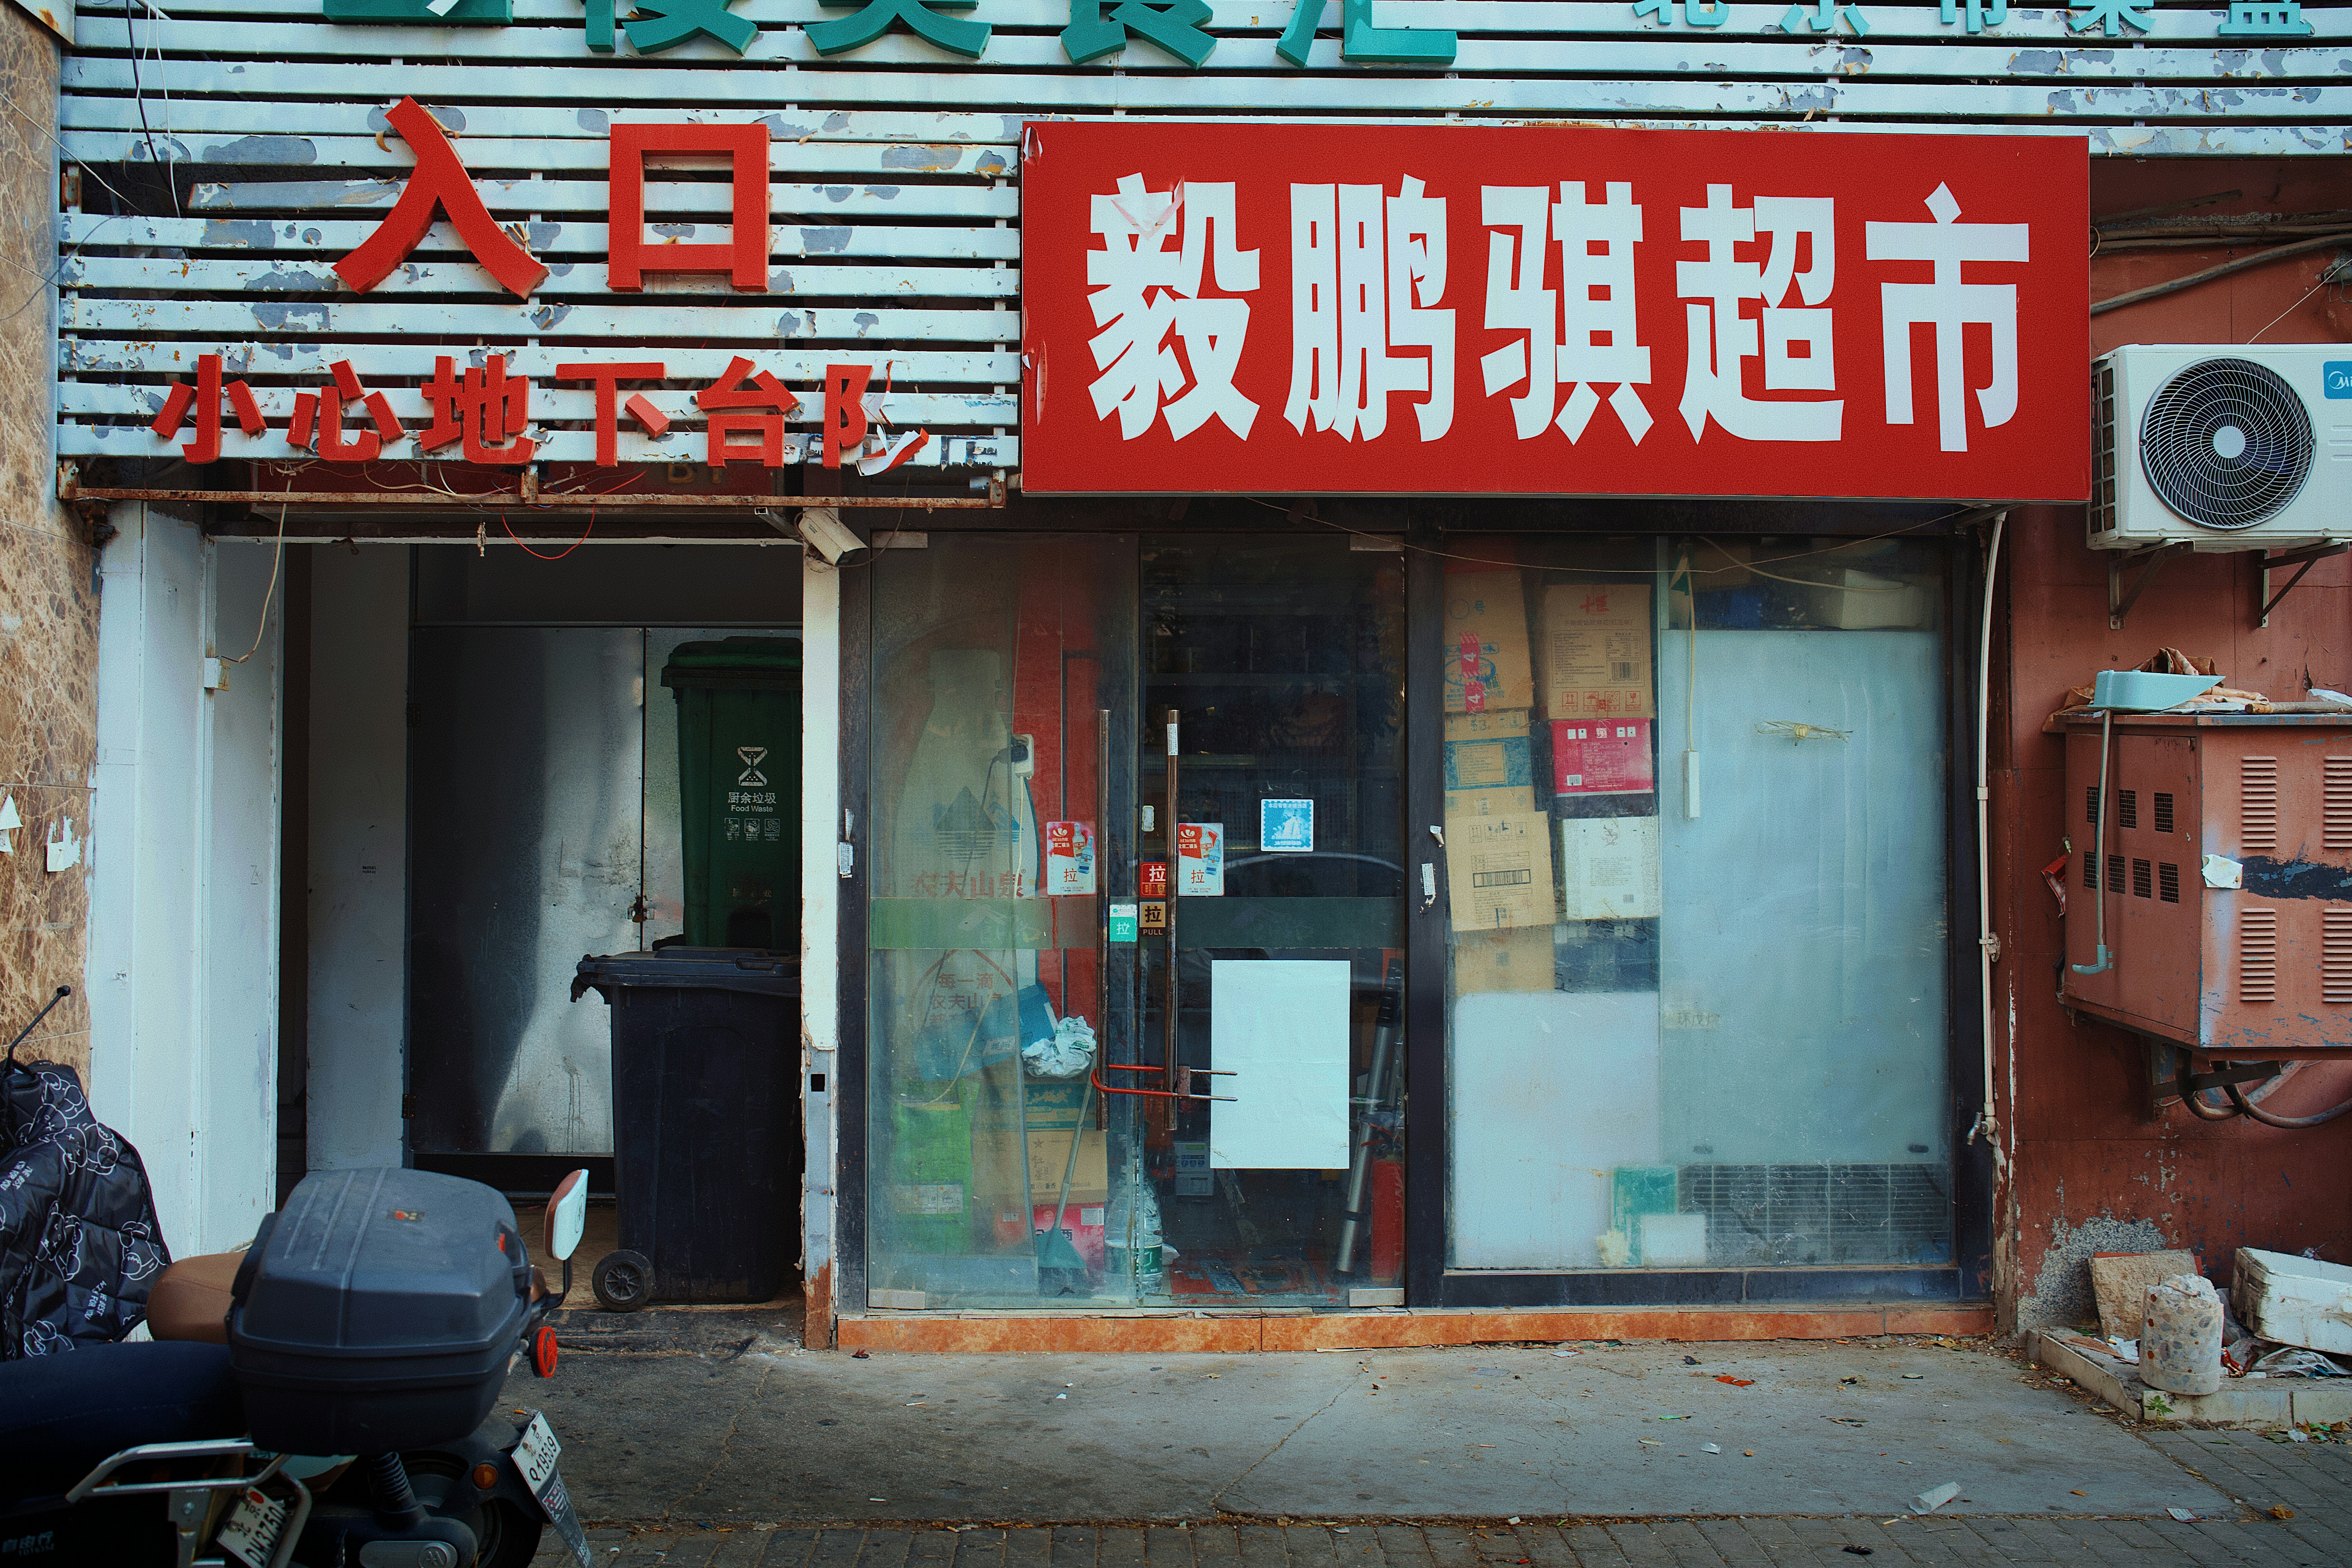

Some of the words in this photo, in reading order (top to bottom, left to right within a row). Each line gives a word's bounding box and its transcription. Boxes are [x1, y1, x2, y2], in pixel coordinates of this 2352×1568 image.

[332, 96, 770, 300] 入口
[1087, 173, 2029, 452] 毅鹏骐超市
[1463, 653, 1476, 662] 4
[1468, 696, 1481, 704] 4
[728, 792, 776, 804] 厨余垃圾
[1064, 868, 1078, 883] 拉
[1149, 865, 1166, 882] 拉
[1191, 870, 1205, 883] 拉
[913, 870, 1024, 898] 农夫山泉
[1145, 906, 1162, 923] 拉
[1117, 922, 1130, 935] 拉
[938, 973, 994, 989] 每一滴
[88, 1295, 98, 1307] FOR
[84, 1309, 94, 1320] YOU
[529, 1436, 557, 1481] Q19539
